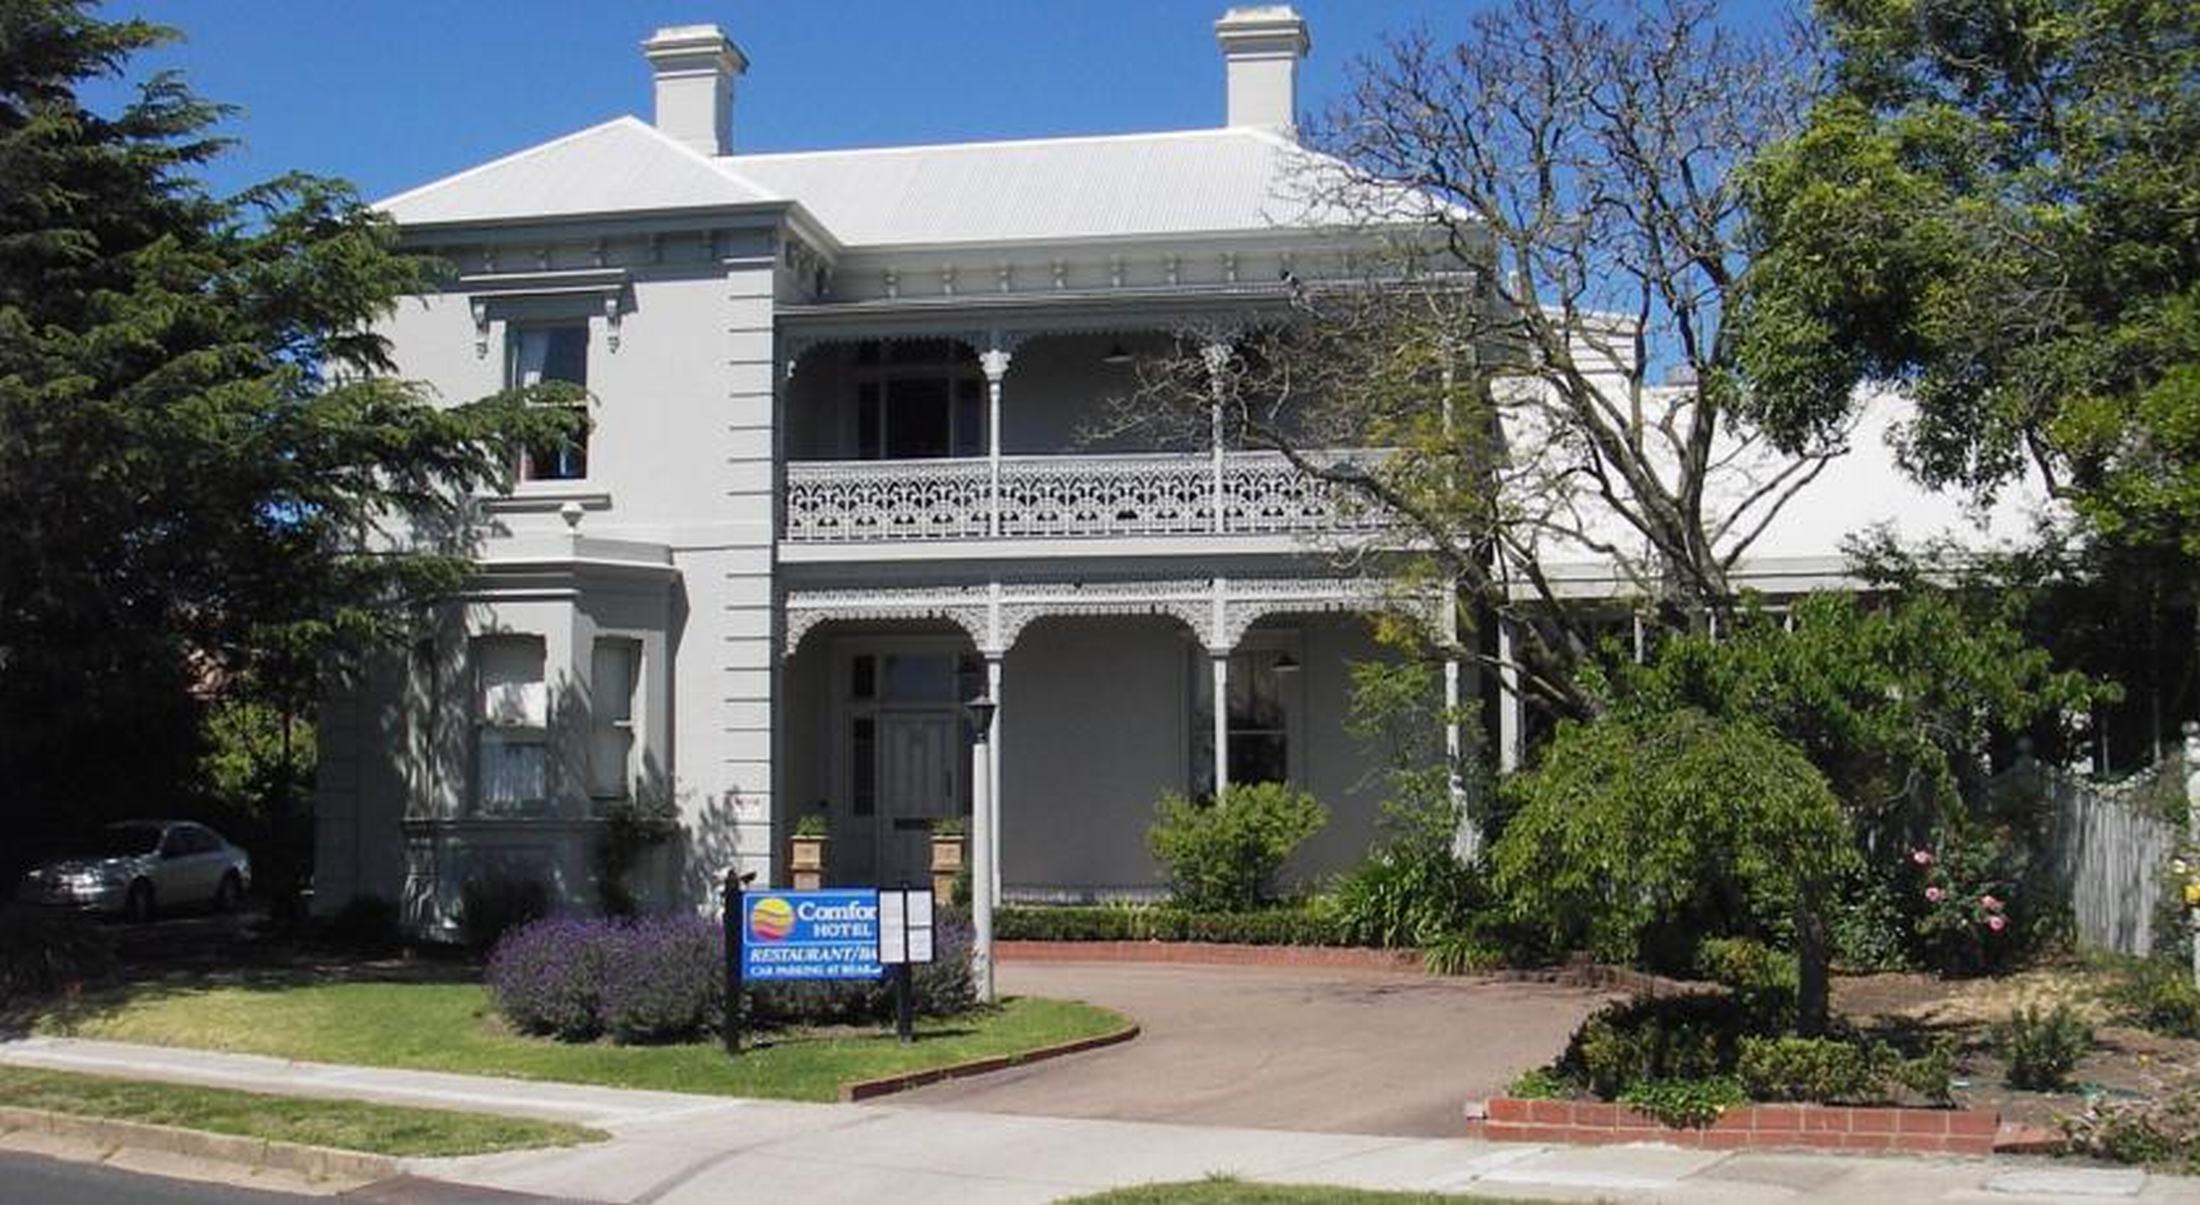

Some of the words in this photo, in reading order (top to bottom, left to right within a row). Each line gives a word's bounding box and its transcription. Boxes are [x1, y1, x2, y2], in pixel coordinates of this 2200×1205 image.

[798, 901, 877, 920] Comfor
[814, 923, 873, 938] HOTEL
[750, 965, 773, 977] CAR
[775, 965, 824, 976] PARKING
